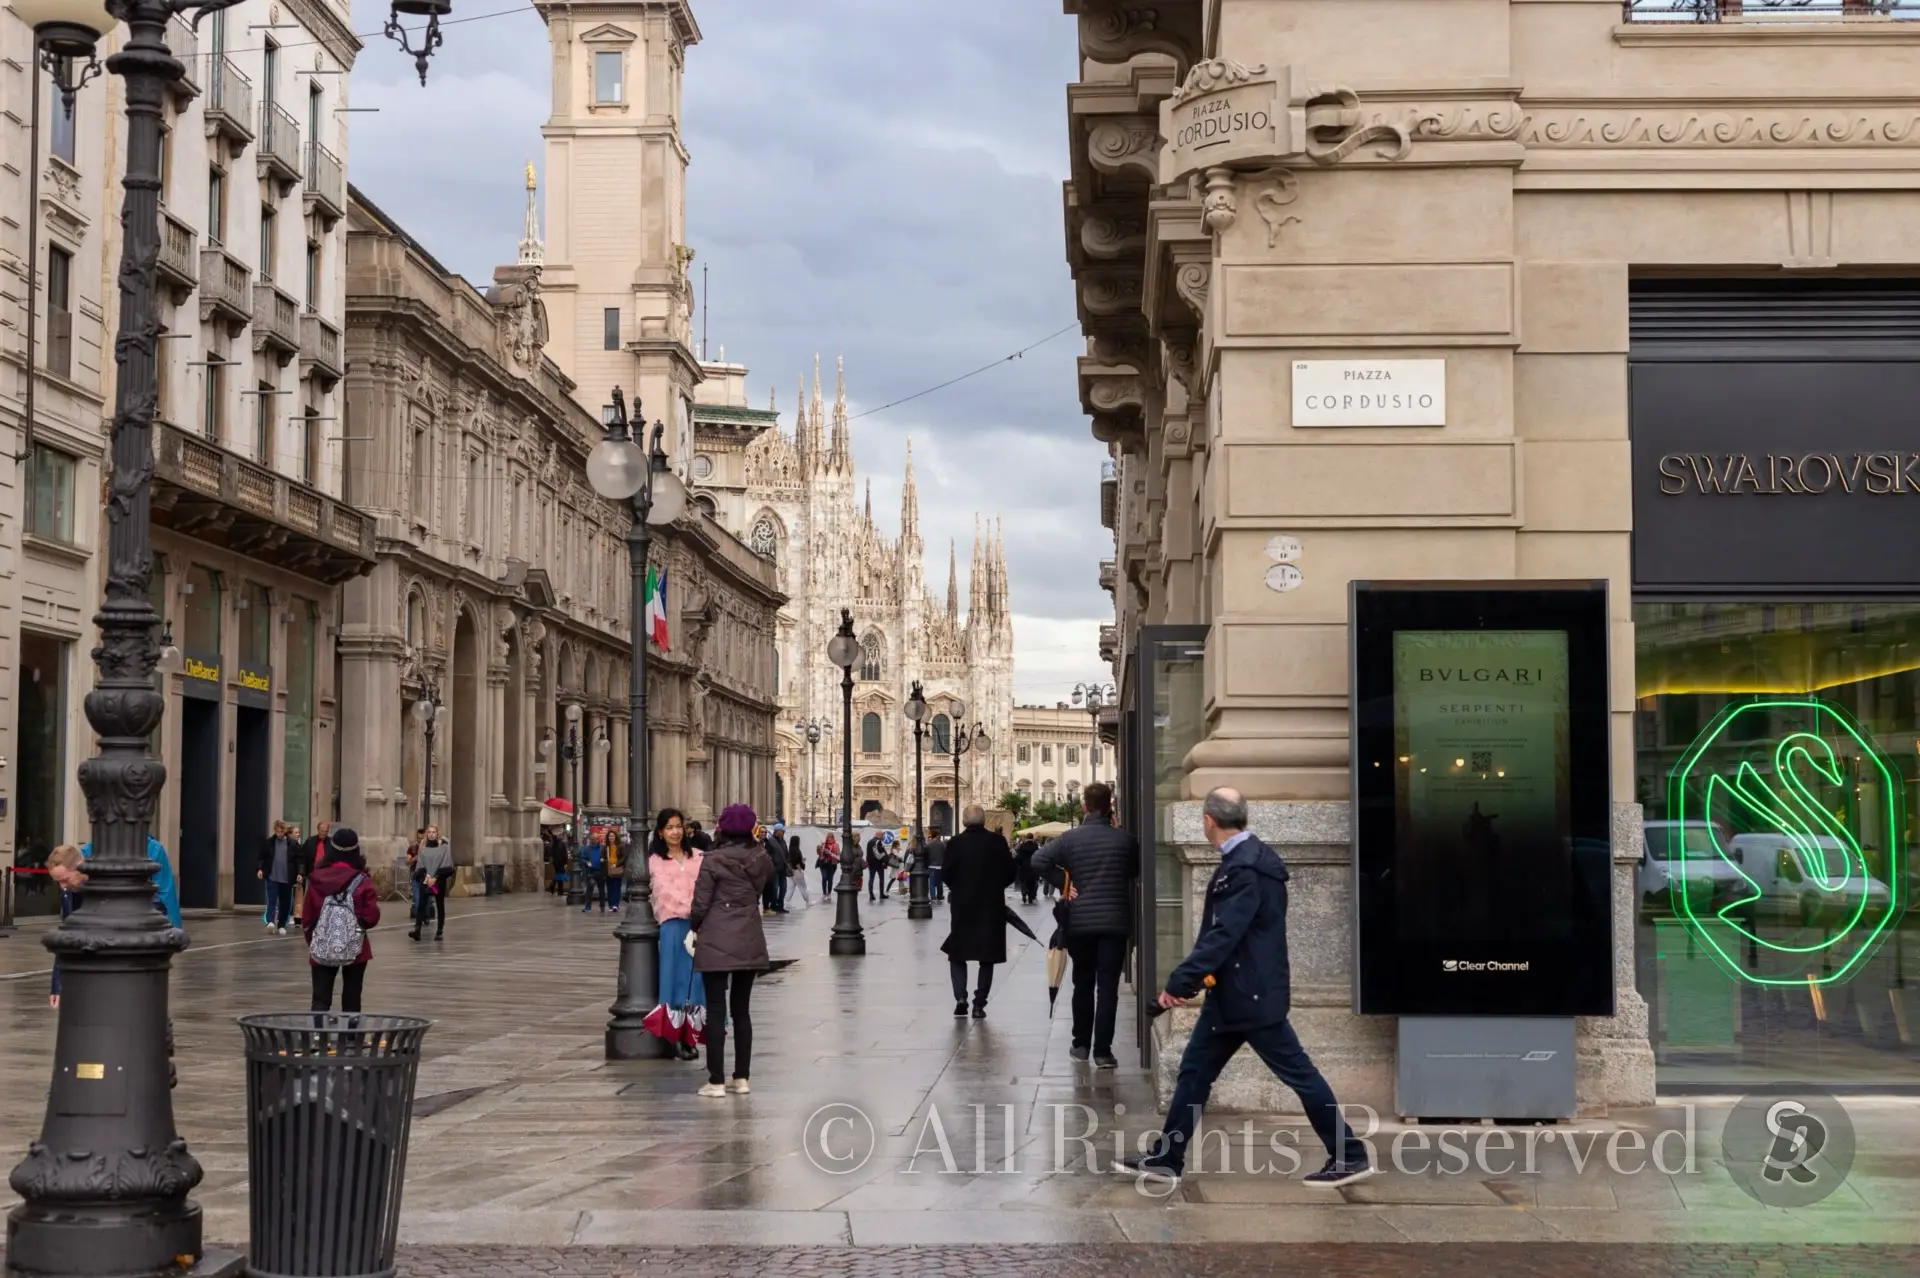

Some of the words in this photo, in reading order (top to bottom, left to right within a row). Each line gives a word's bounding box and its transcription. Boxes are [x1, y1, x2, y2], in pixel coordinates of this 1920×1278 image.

[1193, 99, 1231, 119] PIAZZA
[1178, 111, 1268, 148] CORDUSIO
[1344, 370, 1392, 380] PIAZZA
[1305, 394, 1433, 410] CORDUSIO
[1658, 453, 1920, 495] SWAROVSK
[1419, 668, 1542, 682] BVLGARI
[1439, 704, 1524, 714] SERPENTI
[1458, 961, 1485, 971] Clear
[1487, 960, 1529, 971] Channel
